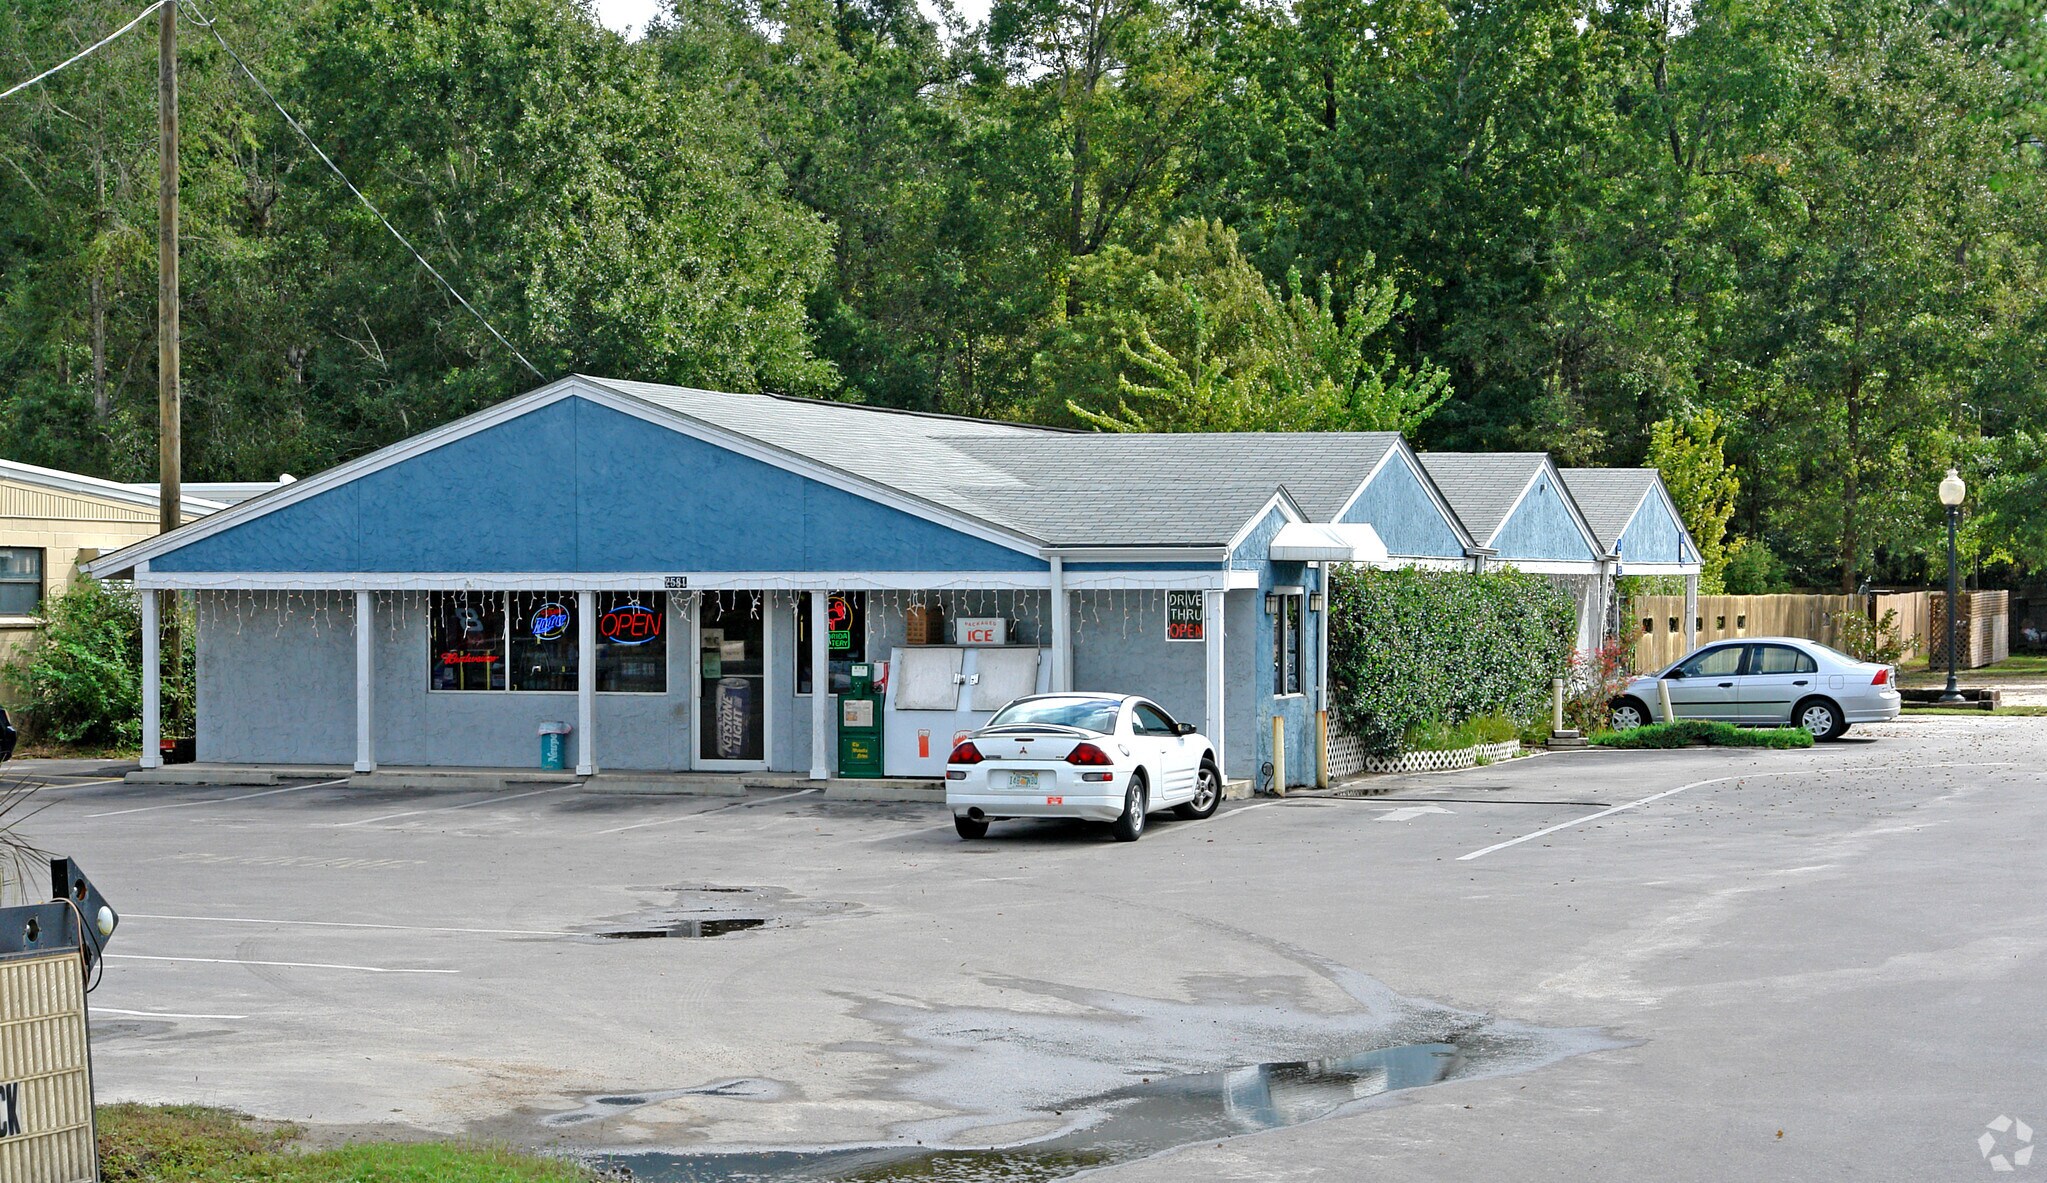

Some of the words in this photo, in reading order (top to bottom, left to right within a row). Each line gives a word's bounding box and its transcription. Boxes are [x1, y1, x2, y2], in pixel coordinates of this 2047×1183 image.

[665, 577, 687, 588] 2581
[1170, 594, 1202, 606] DRIVE
[1171, 608, 1203, 620] THRU
[601, 613, 662, 637] OPEN
[1170, 623, 1203, 638] OPEN
[967, 629, 993, 642] ICE
[830, 639, 848, 647] TERY
[722, 693, 733, 753] KEYSTONE
[732, 707, 743, 747] LIGHT
[547, 733, 560, 763] Newpo
